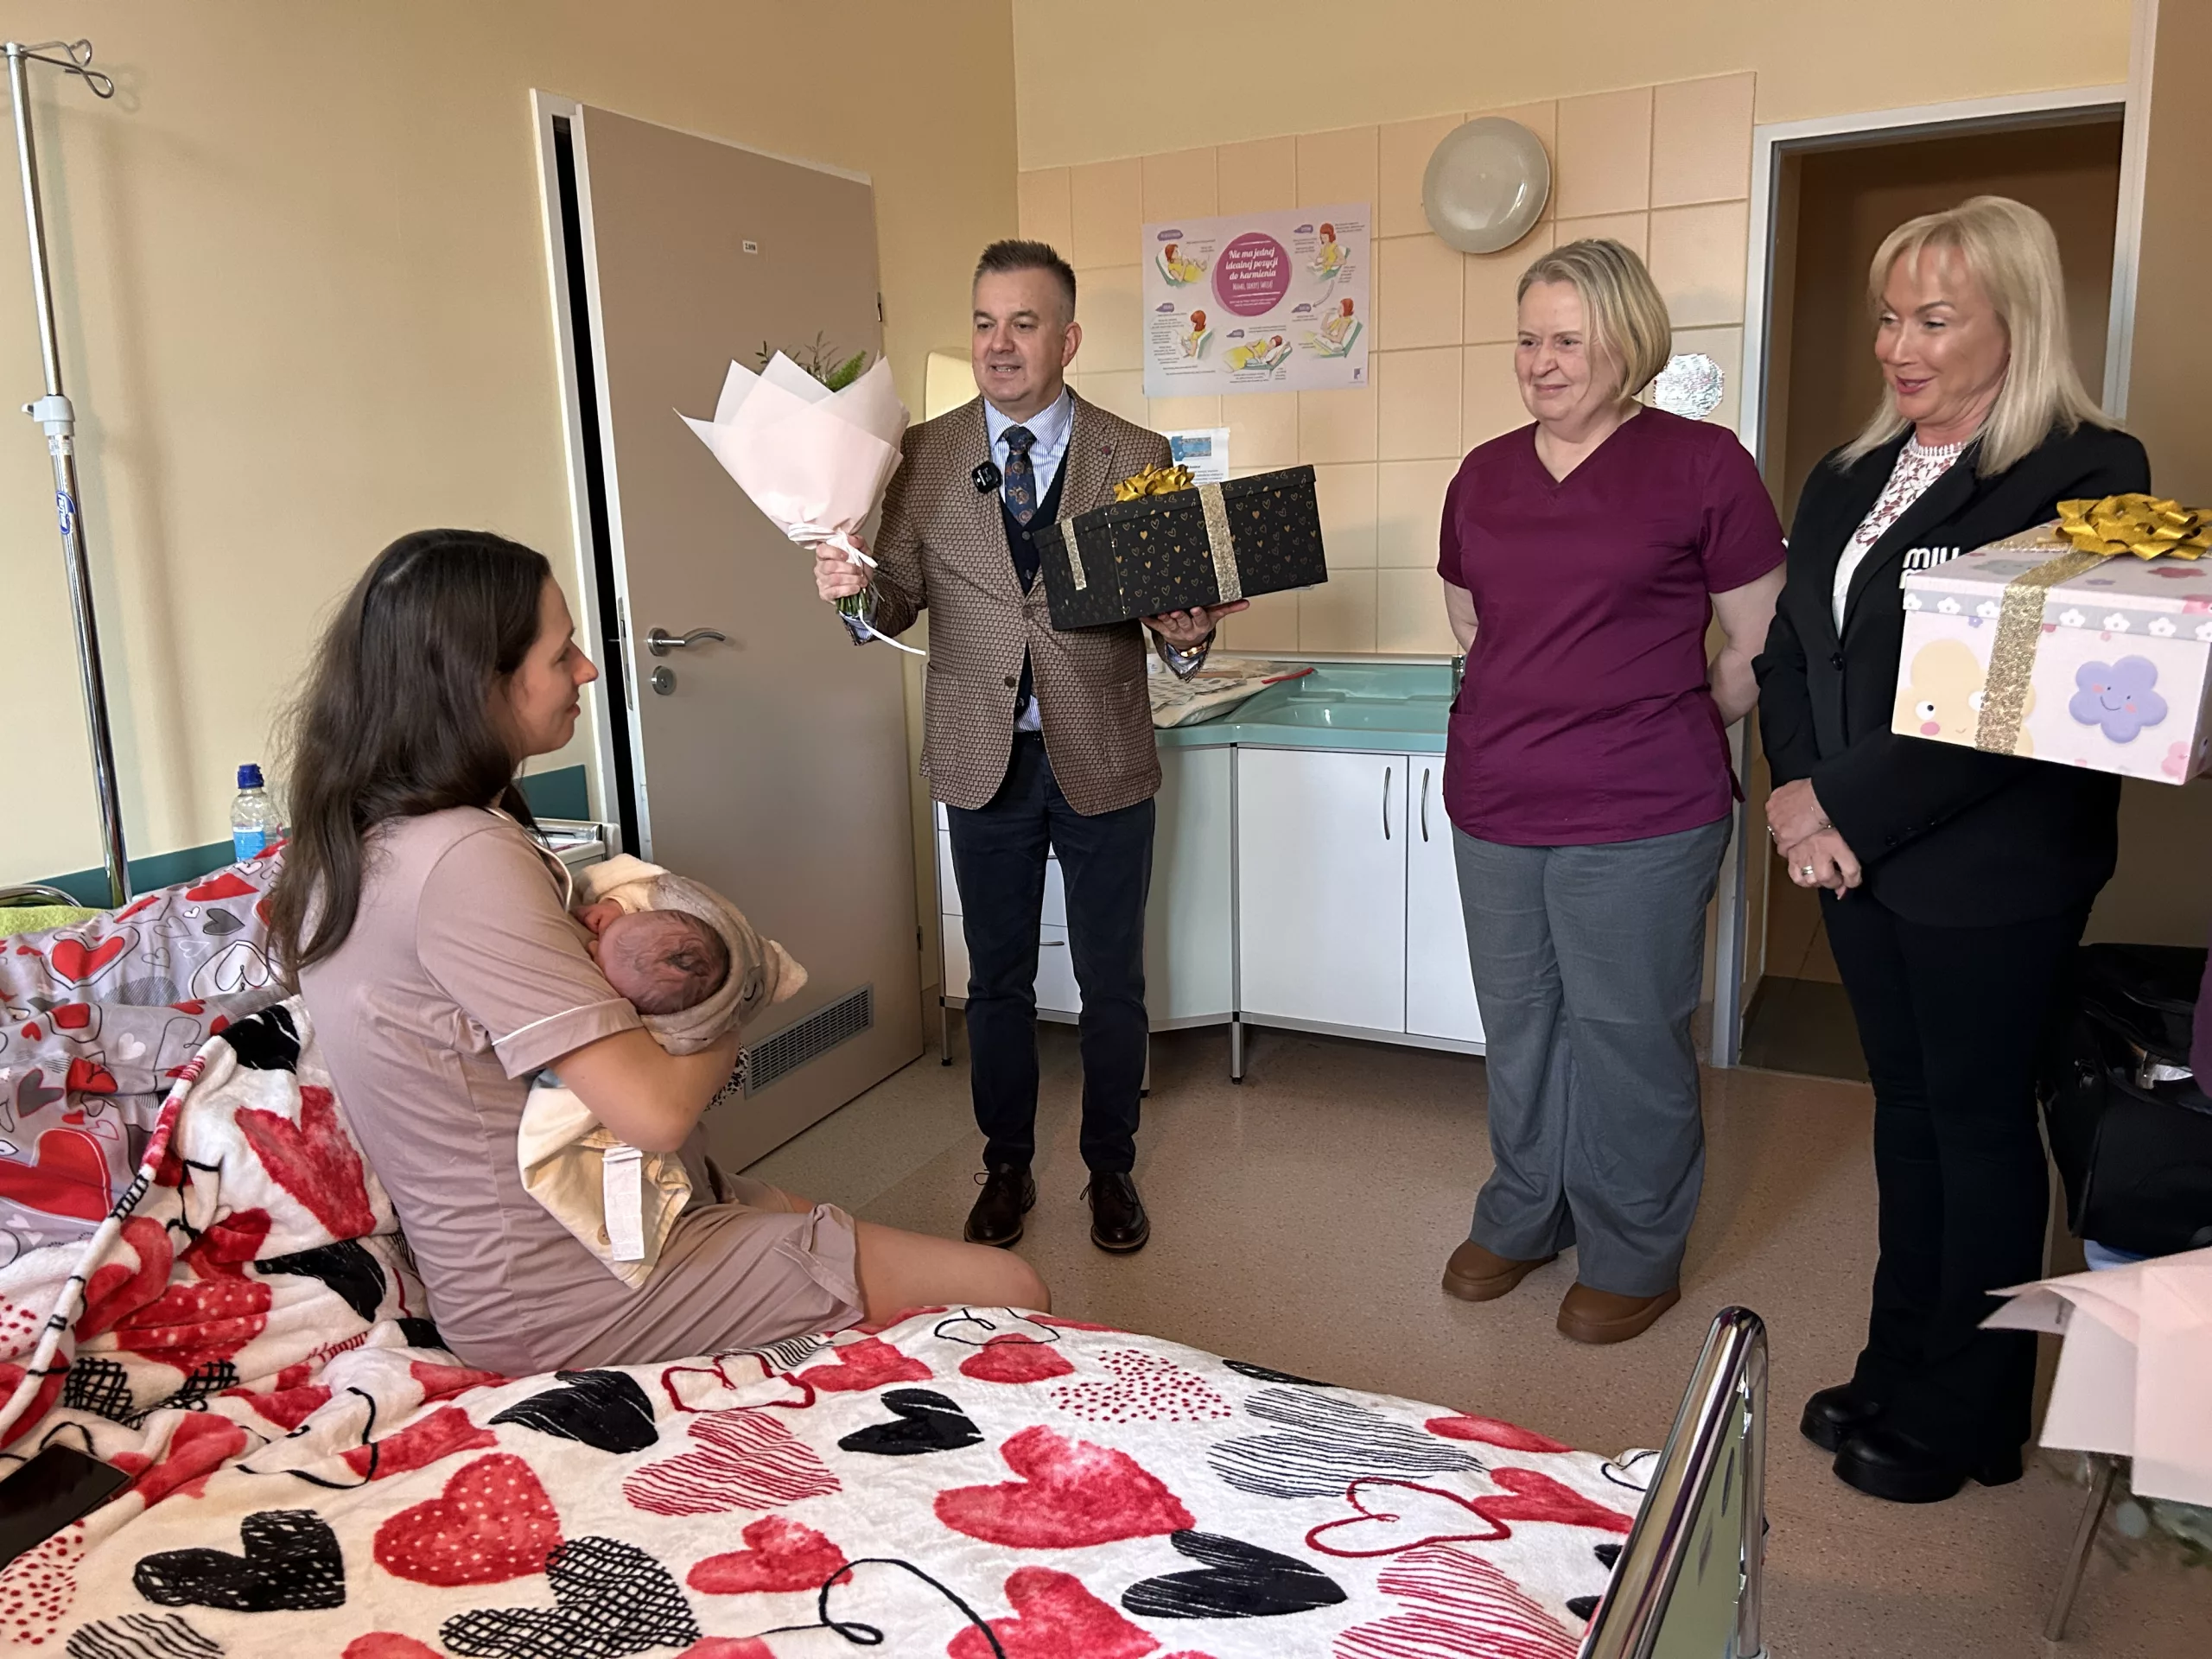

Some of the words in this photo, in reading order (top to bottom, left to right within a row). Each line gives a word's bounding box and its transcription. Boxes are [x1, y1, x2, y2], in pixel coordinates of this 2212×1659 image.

[1229, 250, 1240, 259] Nie
[1252, 246, 1275, 259] jednej
[1225, 260, 1253, 270] idealnej
[1253, 257, 1279, 270] pozycji
[1229, 271, 1238, 281] do
[1239, 269, 1276, 279] karmienia
